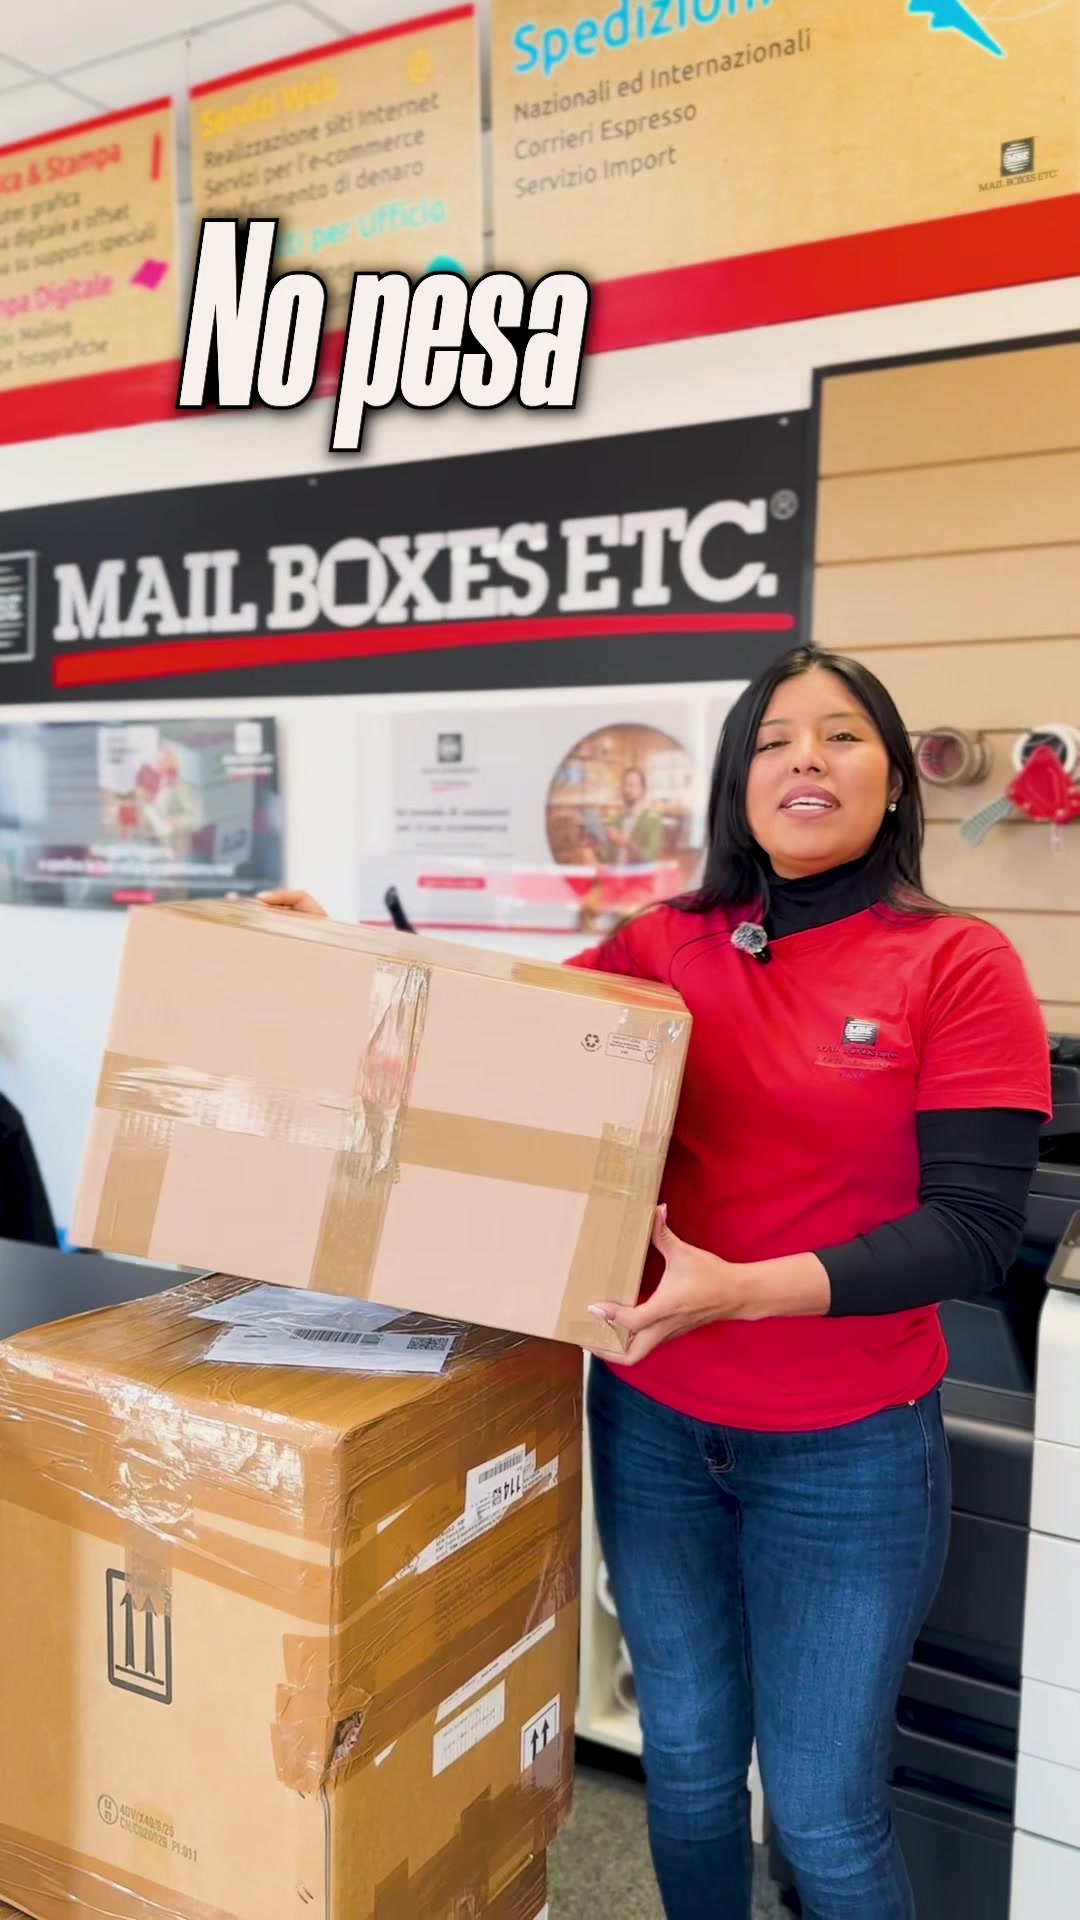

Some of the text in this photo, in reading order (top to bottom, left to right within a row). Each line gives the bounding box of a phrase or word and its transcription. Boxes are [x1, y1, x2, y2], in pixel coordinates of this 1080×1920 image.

[512, 0, 771, 78] Spedizio
[513, 27, 812, 123] Nazionali ed Internazionali
[204, 90, 440, 168] Realizzazione siti Internet
[513, 102, 697, 161] Corrieri Espresso
[47, 145, 122, 181] Stampa
[204, 170, 260, 199] Servizi
[263, 160, 294, 187] per
[334, 172, 351, 195] di
[355, 159, 425, 191] denaro
[514, 145, 677, 200] Servizio Import
[1005, 173, 1036, 188] BOXES
[311, 222, 351, 257] per
[356, 199, 449, 242] Ufficio
[53, 550, 258, 641] MAIL
[266, 521, 549, 632] BOXES
